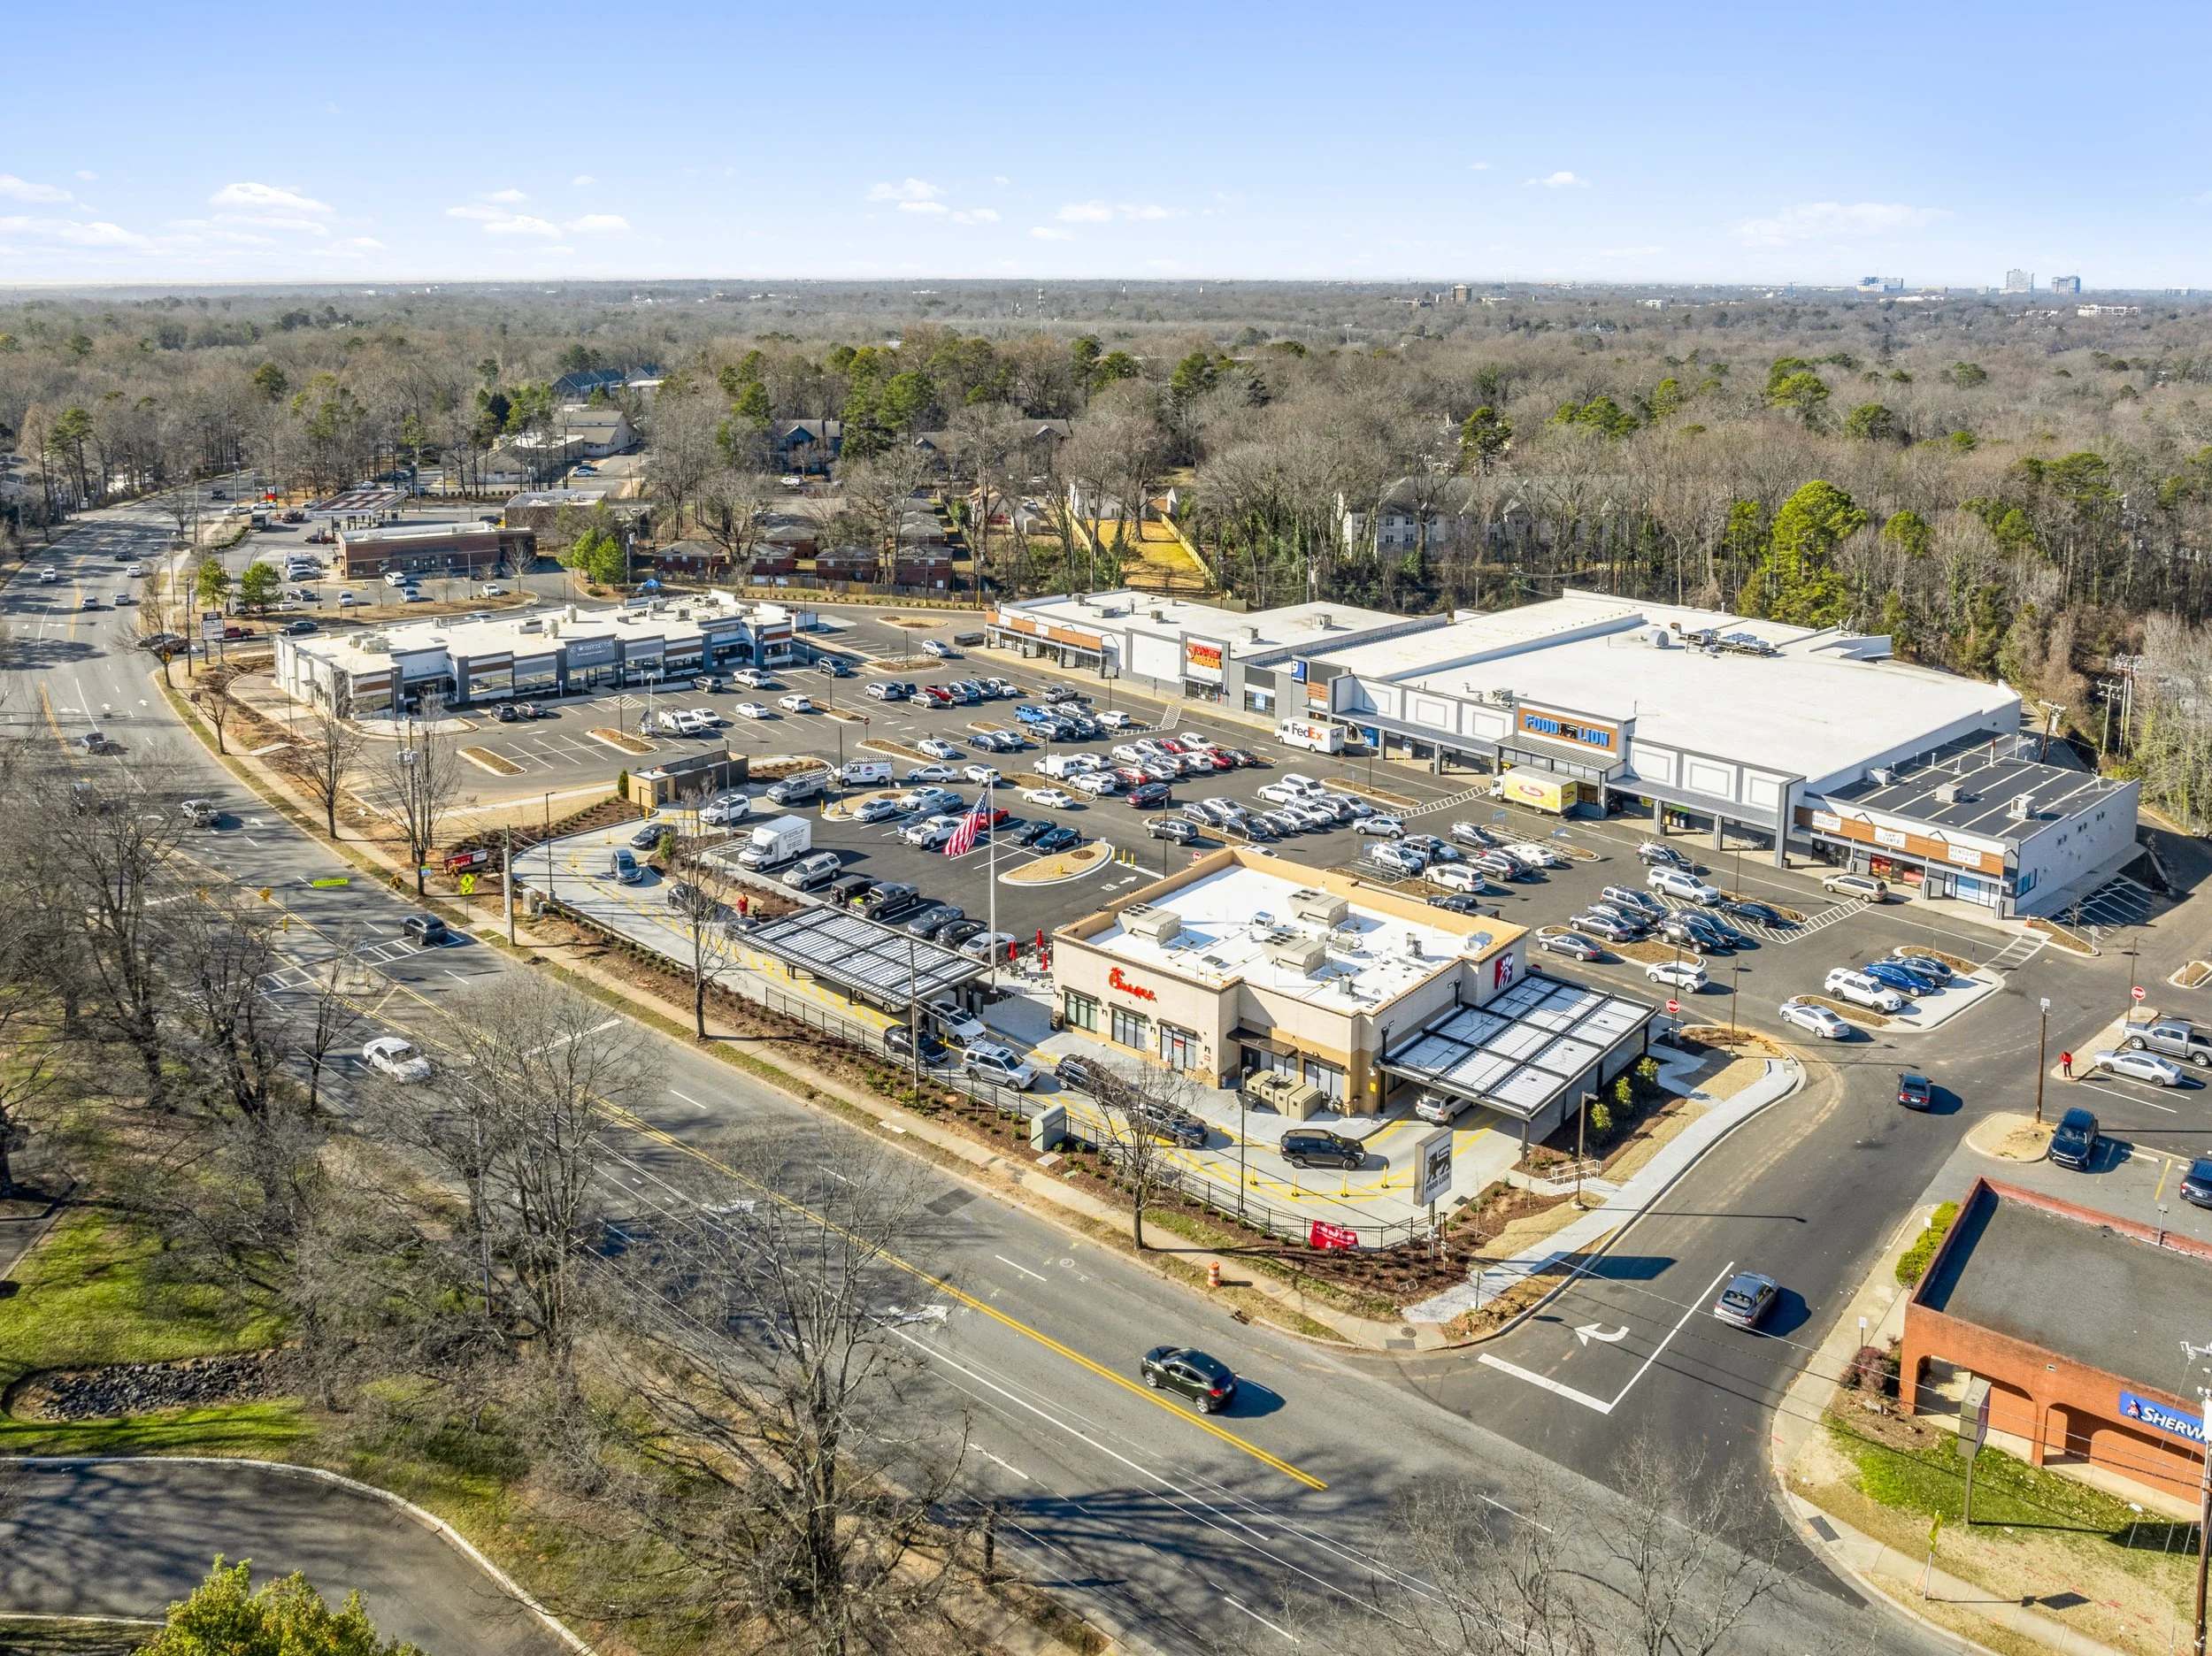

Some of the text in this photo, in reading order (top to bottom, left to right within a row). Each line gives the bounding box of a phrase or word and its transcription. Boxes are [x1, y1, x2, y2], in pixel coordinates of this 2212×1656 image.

[1292, 723, 1323, 741] FedEx
[1525, 714, 1609, 747] FOOD LION
[1425, 1179, 1439, 1192] FOOD
